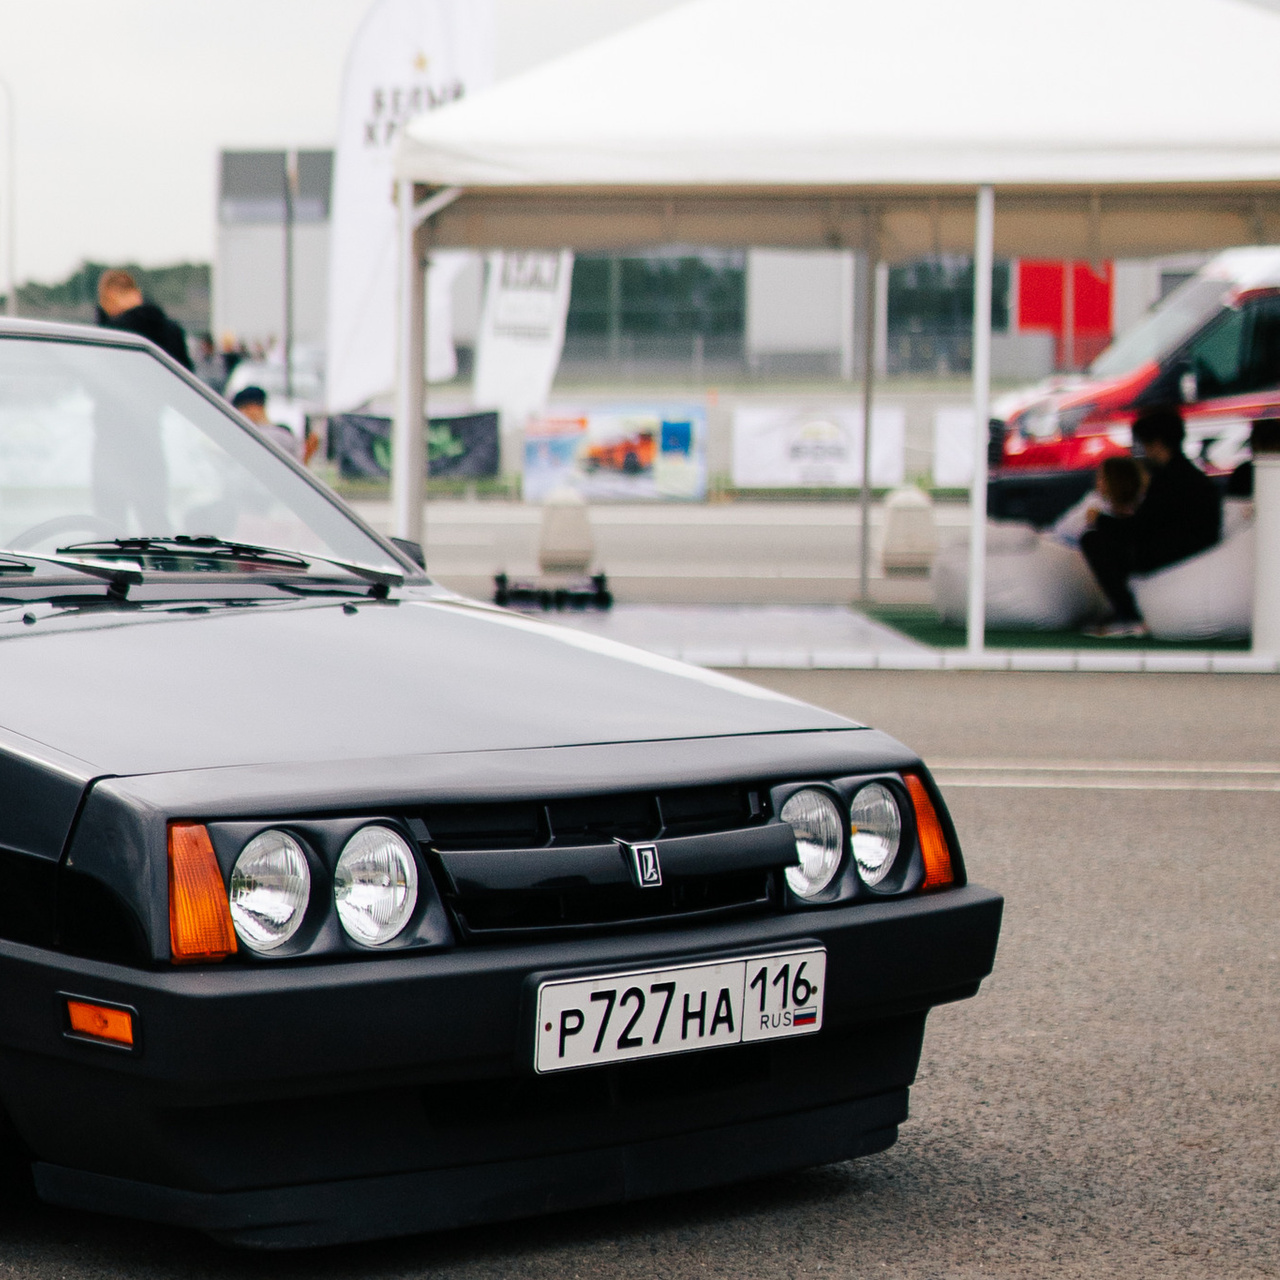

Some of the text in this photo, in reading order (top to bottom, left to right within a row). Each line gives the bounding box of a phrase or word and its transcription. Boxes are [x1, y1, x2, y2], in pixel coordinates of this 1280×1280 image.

[558, 961, 812, 1058] Р727НА 116
[760, 1011, 792, 1030] RUS
